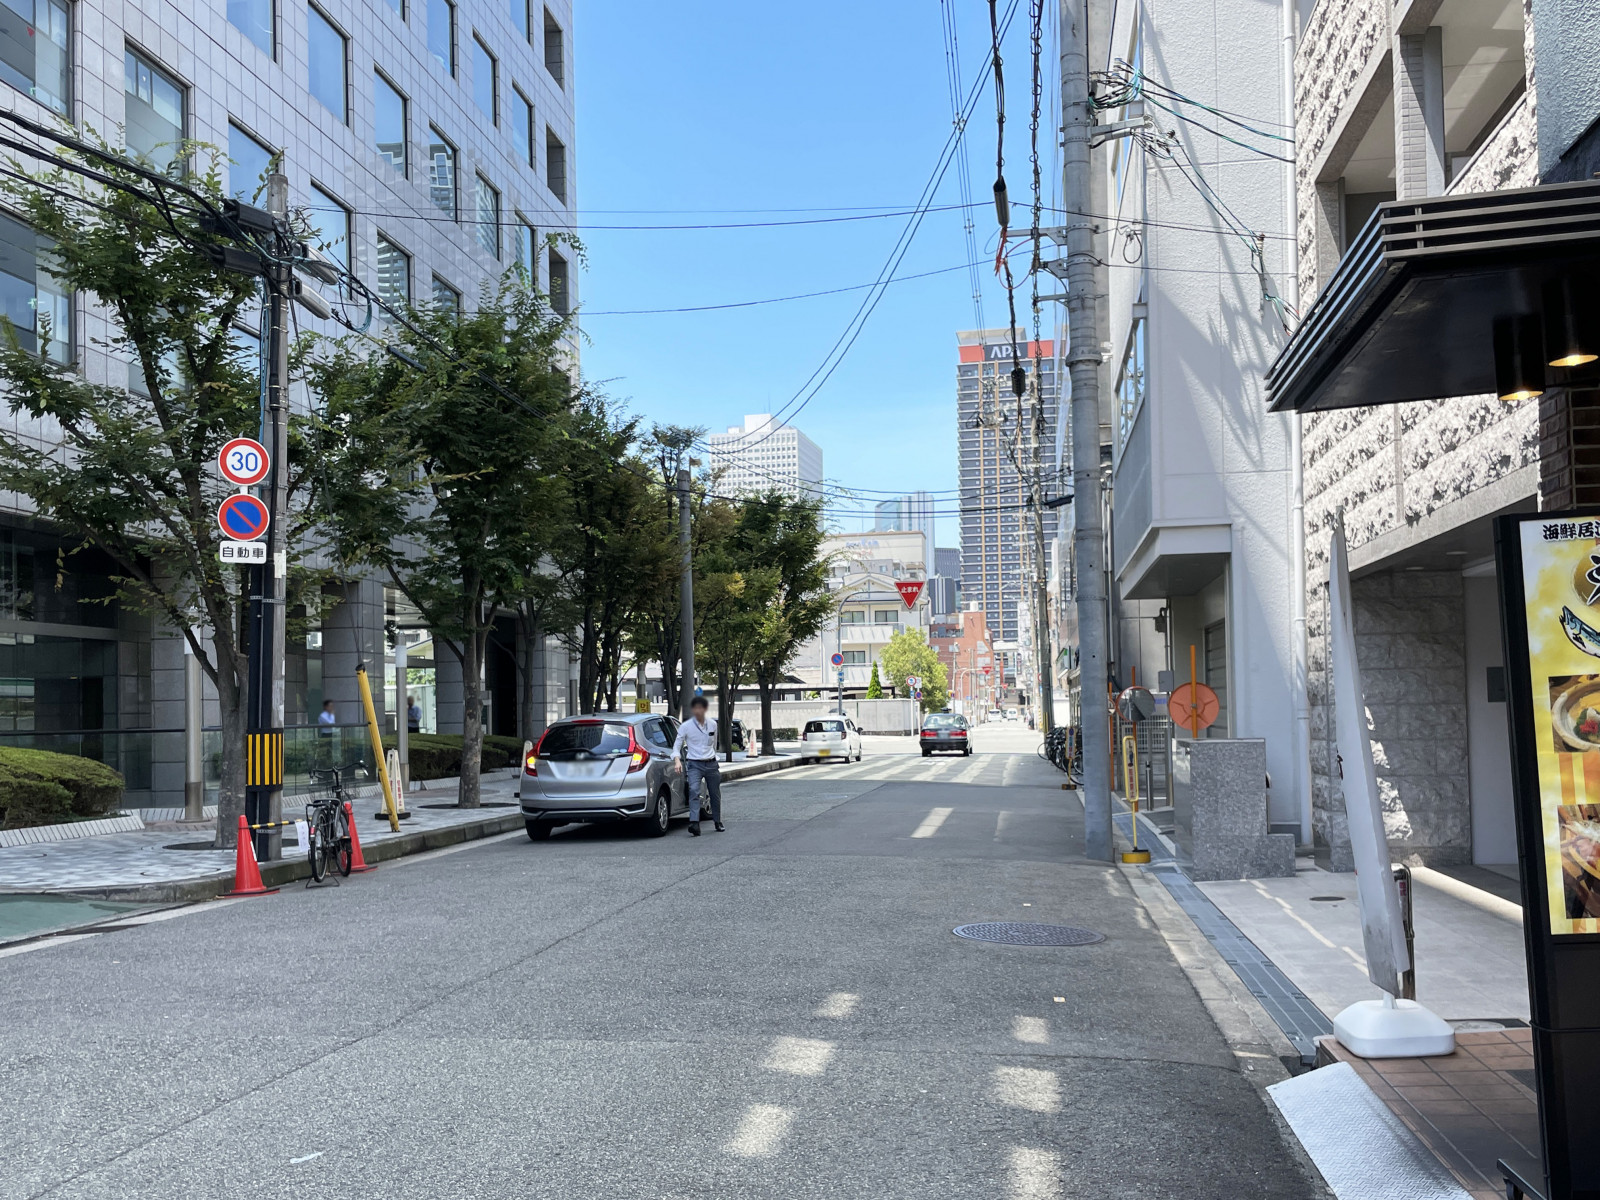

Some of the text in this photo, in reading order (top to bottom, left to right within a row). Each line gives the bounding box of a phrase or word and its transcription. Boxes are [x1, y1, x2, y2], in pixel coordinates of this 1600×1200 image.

[231, 451, 258, 472] 30
[1542, 520, 1600, 540] 海鮮居
[222, 546, 264, 559] 自動車
[901, 586, 919, 594] 止まれ
